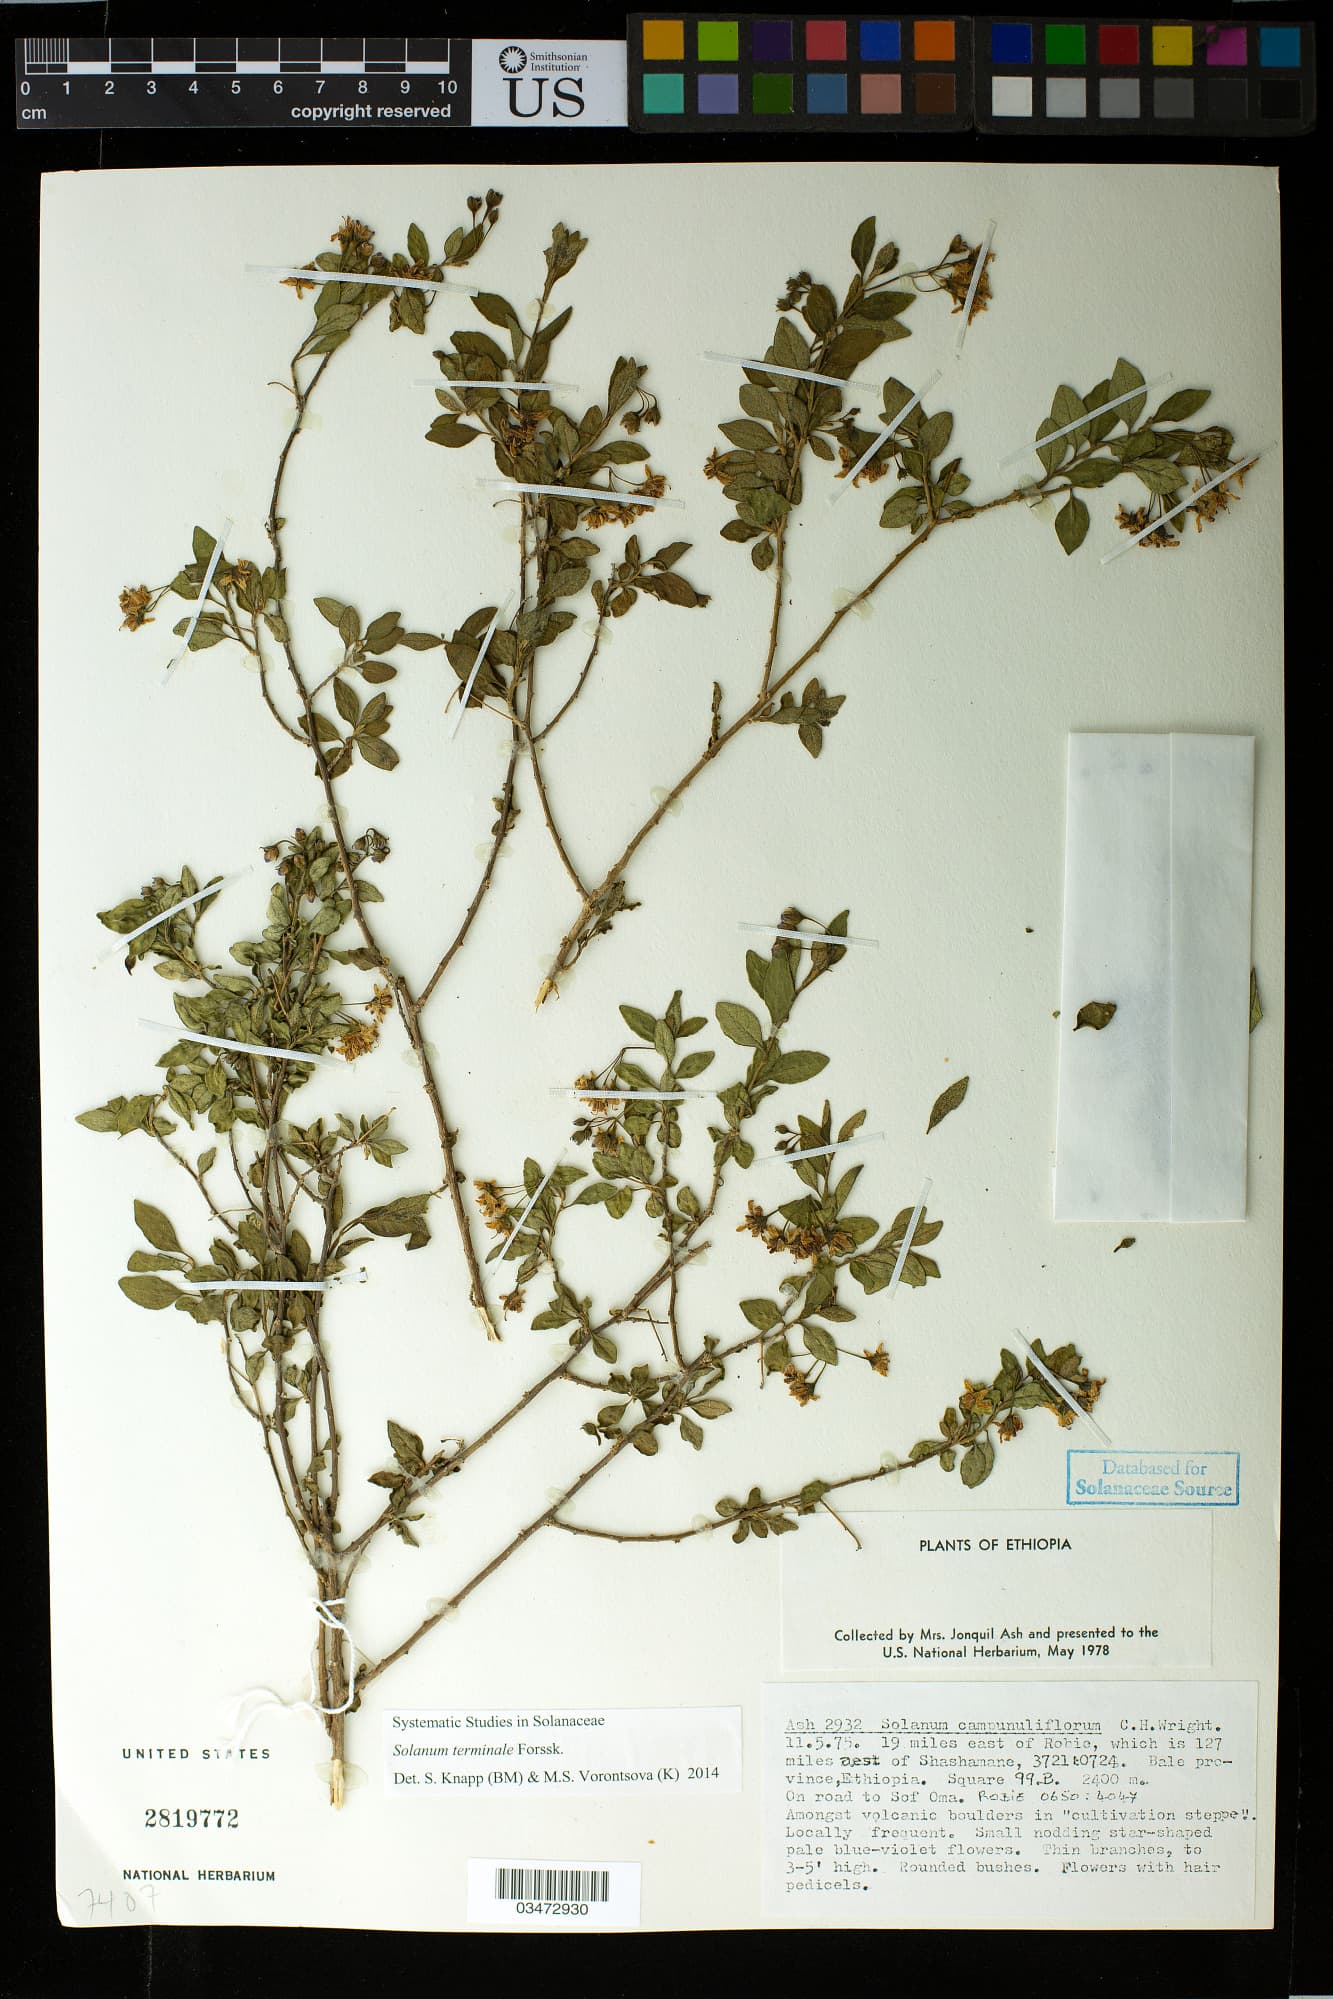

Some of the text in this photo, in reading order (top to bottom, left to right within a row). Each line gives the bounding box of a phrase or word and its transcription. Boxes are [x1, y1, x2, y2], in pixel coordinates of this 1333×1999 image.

[530, 52, 587, 61] Smithsonian
[531, 63, 580, 71] Institution
[21, 80, 457, 95] 0 1 2 3 4 5 6 7 8 9 10
[503, 78, 585, 118] US
[22, 109, 46, 119] cm
[292, 104, 450, 121] copyright reserved
[1103, 1460, 1207, 1475] Databased for
[1076, 1479, 1232, 1496] Solanaceae Source
[920, 1538, 1072, 1552] PLANTS OF ETHIOPIA
[835, 1625, 1158, 1644] Collected by Mrs. Jonquil Ash and presented to the
[883, 1645, 1109, 1659] U.S. National Herbarium, May 1978
[393, 1715, 605, 1731] Systematic Studies in Solanaceae
[786, 1719, 815, 1731] Ash
[825, 1719, 862, 1731] 2932
[881, 1719, 948, 1730] Solanum
[393, 1743, 563, 1756] Solanum terminale Forssk.
[881, 1736, 900, 1749] 19
[910, 1736, 957, 1749] miles
[968, 1737, 1004, 1749] east
[1016, 1738, 1034, 1749] of
[1111, 1737, 1158, 1749] which
[1169, 1737, 1185, 1749] is
[1196, 1737, 1222, 1749] 127
[123, 1749, 189, 1759] UNITED
[786, 1755, 833, 1767] miles
[892, 1755, 910, 1767] of
[920, 1755, 1022, 1769] Shashamane,
[1149, 1755, 1185, 1766] Bale
[1196, 1759, 1232, 1769] pro-
[394, 1767, 719, 1787] Det. S. Knapp (BM) & M.S. Vorontsova (K) 2014
[948, 1773, 1004, 1787] Square
[1082, 1774, 1119, 1786] 2400
[786, 1791, 805, 1802] On
[815, 1790, 853, 1802] road
[863, 1791, 880, 1802] to
[891, 1790, 919, 1802] Sof
[929, 1791, 964, 1803] Oma.
[144, 1808, 239, 1828] 2819772
[786, 1810, 851, 1822] Amongst
[862, 1810, 937, 1821] volcanic
[949, 1809, 1023, 1820] boulders
[1035, 1809, 1052, 1820] in
[786, 1827, 1212, 1840] Locally frequent. Small nodding star-shaped
[786, 1844, 1201, 1858] pale blue-violet flowers. Thin branches, to
[834, 1861, 878, 1875] high.
[900, 1861, 965, 1872] Rounded
[976, 1861, 1039, 1873] bushes.
[1062, 1862, 1127, 1873] Flowers
[1137, 1862, 1174, 1873] with
[1184, 1861, 1220, 1873] hair
[123, 1870, 275, 1881] NATIONAL HERBARIUM
[786, 1879, 868, 1892] pedicels.
[516, 1903, 589, 1917] 03472930
